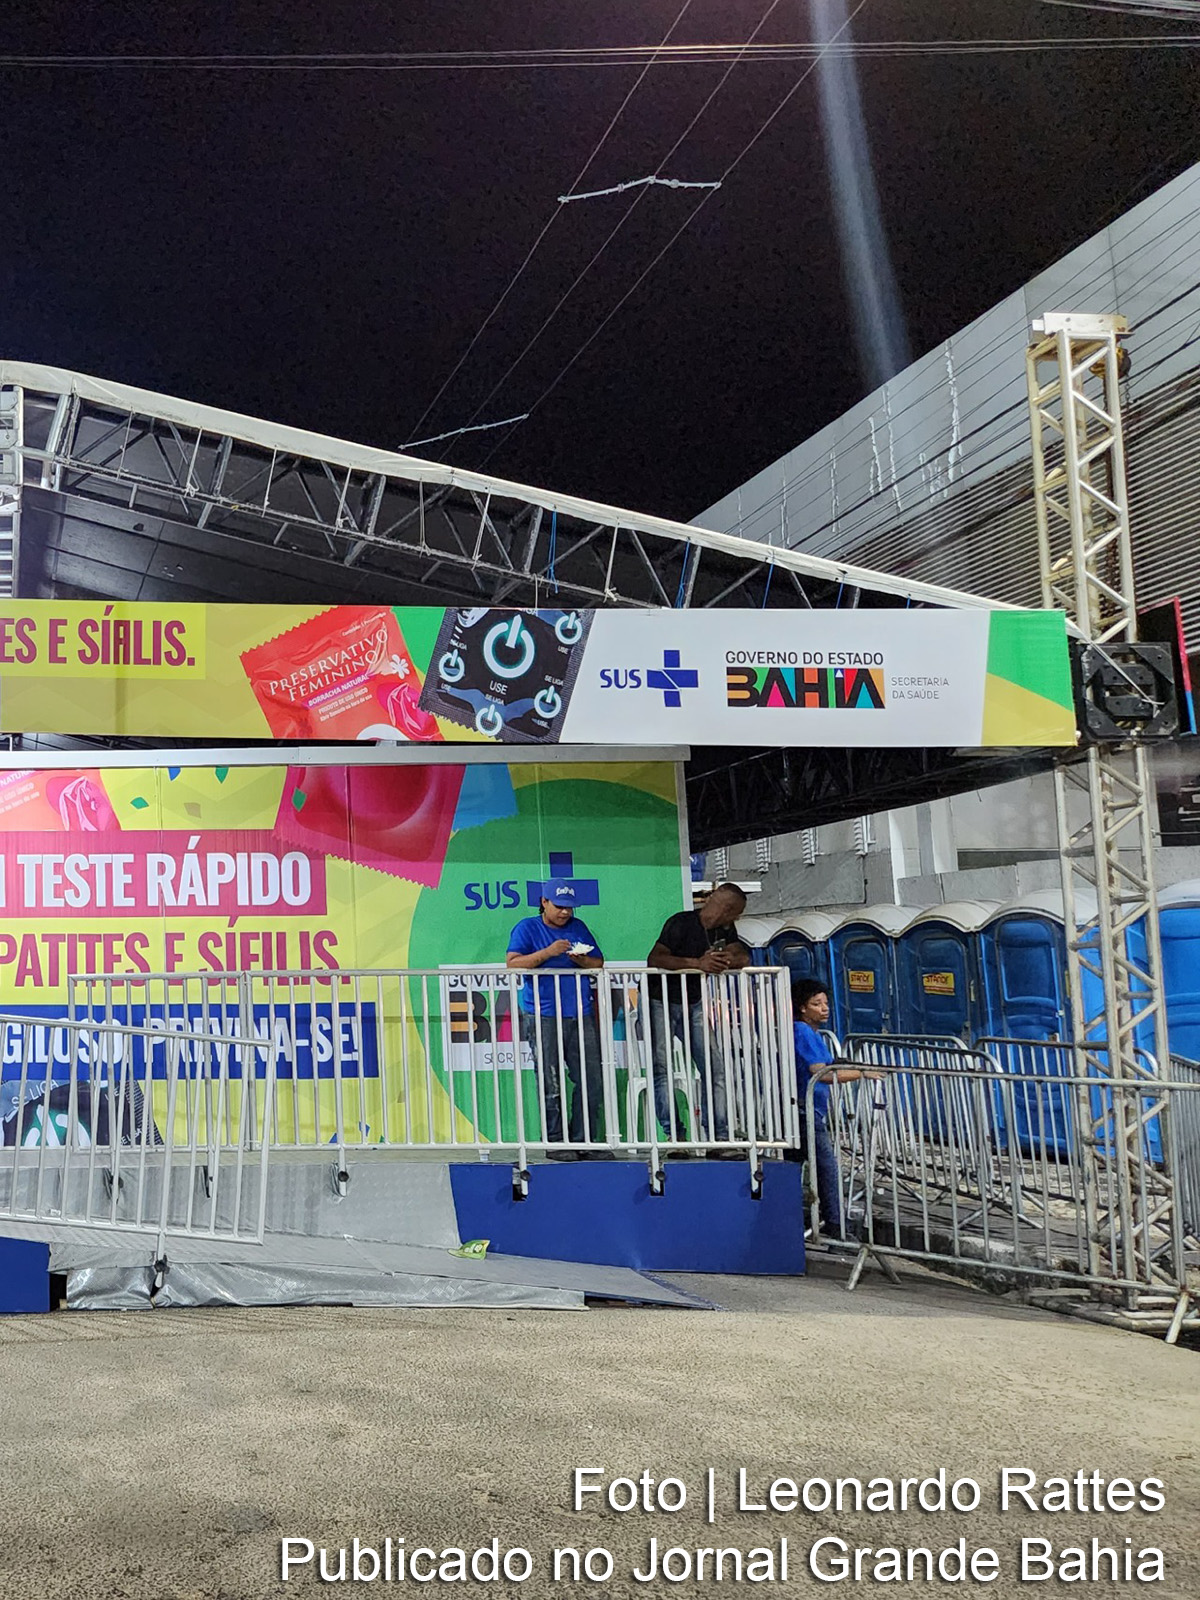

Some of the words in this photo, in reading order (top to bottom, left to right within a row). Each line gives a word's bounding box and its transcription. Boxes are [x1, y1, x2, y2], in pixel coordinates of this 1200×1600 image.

[49, 618, 67, 664] E
[269, 629, 388, 696] PRESERVATIVO
[725, 651, 797, 665] GOVERNO
[803, 651, 823, 665] DO
[828, 652, 884, 666] ESTADO
[288, 650, 378, 702] FEMININO
[489, 681, 508, 695] USE
[600, 669, 642, 689] SUS
[726, 666, 886, 709] BAHIA
[891, 676, 950, 687] SECRETARIA
[308, 687, 341, 707] BORRACHA
[892, 690, 906, 699] DA
[907, 687, 940, 700] SAÚDE
[16, 853, 135, 908] TESTE
[146, 836, 311, 907] RÁPIDO
[464, 880, 520, 911] SUS
[165, 932, 186, 986] E
[198, 916, 350, 986] SÍFILIS.
